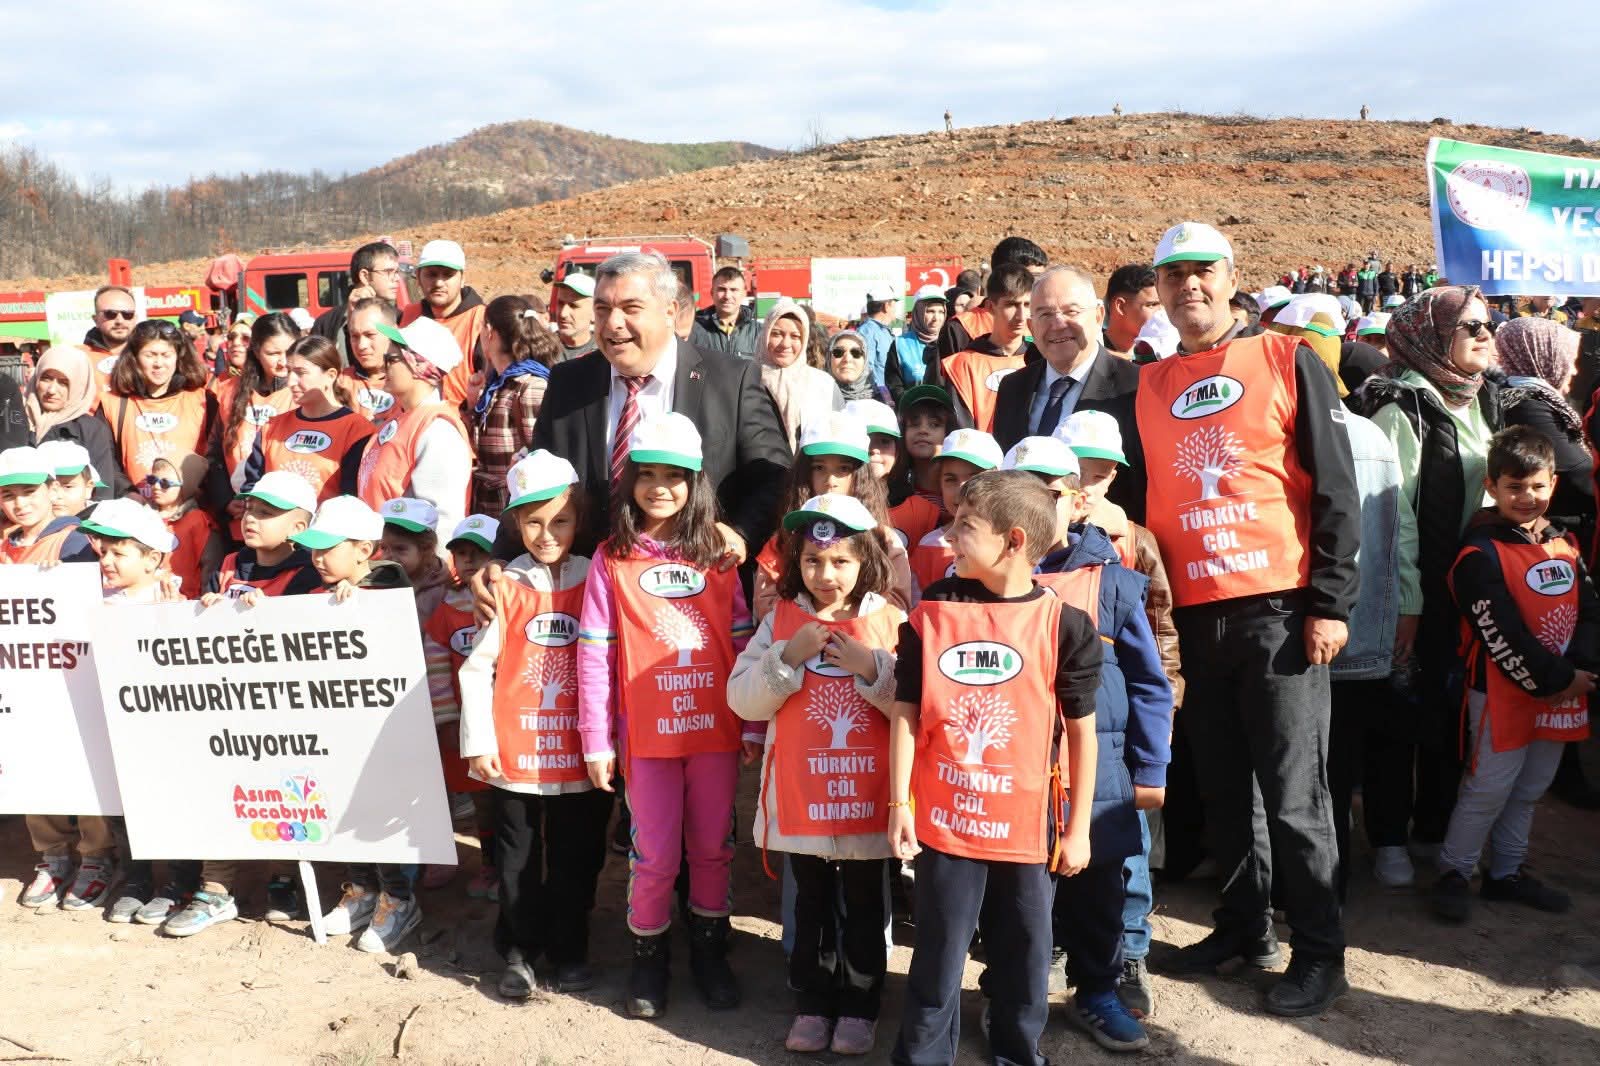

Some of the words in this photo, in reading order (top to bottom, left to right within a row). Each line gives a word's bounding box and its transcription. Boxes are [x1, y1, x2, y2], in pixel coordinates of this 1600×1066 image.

[1185, 382, 1219, 407] TEMA
[294, 433, 318, 446] TEMA
[1178, 500, 1259, 532] TÜRKİYE
[1202, 527, 1241, 556] ÇÖL
[1186, 549, 1270, 580] OLMASIN
[1535, 565, 1566, 584] TEMA
[653, 570, 690, 585] TEMA
[536, 619, 567, 634] TEMA
[137, 628, 279, 667] "GELECEĞE
[281, 629, 368, 662] NEFES
[957, 650, 1000, 668] TEMA
[655, 670, 714, 692] TÜRKİYE
[118, 677, 305, 713] CUMHURİYET'E
[307, 677, 408, 710] NEFES"
[672, 691, 698, 717] ÇÖL
[657, 713, 715, 735] OLMASIN
[209, 728, 329, 762] oluyoruz.
[535, 732, 564, 754] ÇÖL
[807, 751, 876, 775] TÜRKİYE
[827, 775, 858, 800] ÇÖL
[936, 760, 1014, 794] TÜRKİYE
[233, 784, 283, 802] Asım
[953, 791, 988, 817] ÇÖL
[234, 803, 328, 824] Kocabıyık
[808, 801, 875, 821] OLMASIN
[930, 806, 1011, 840] OLMASIN
